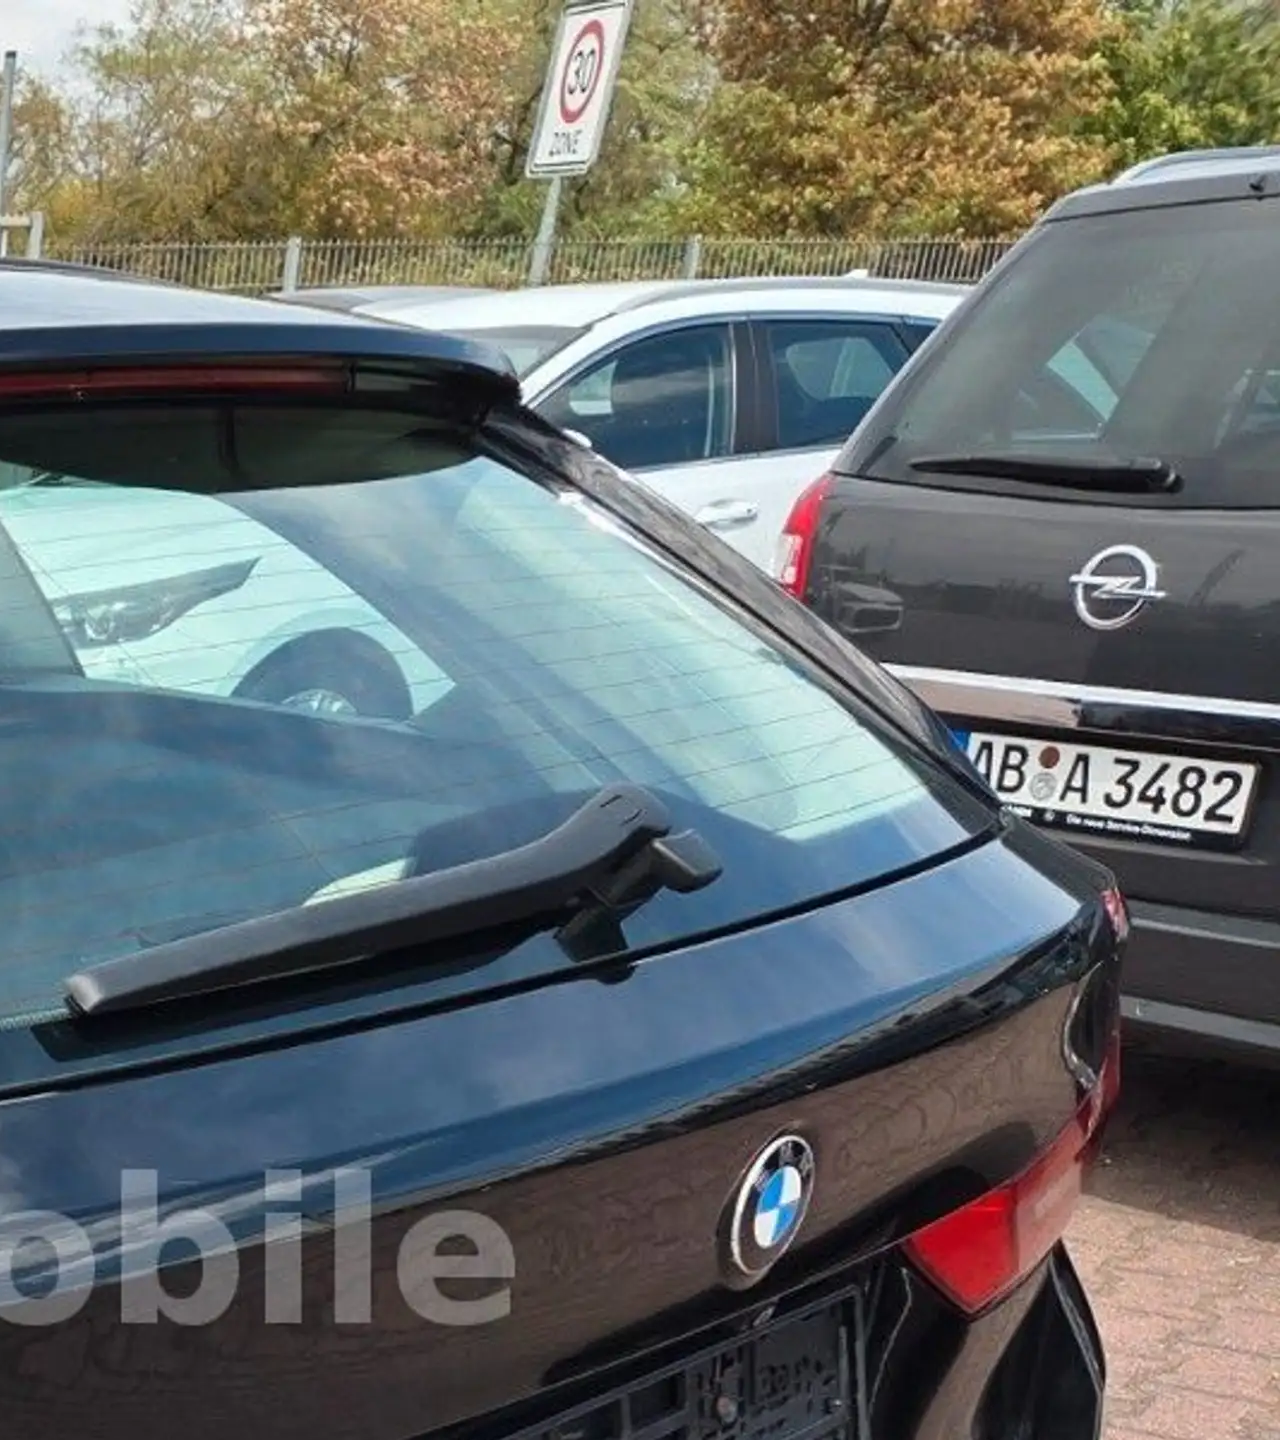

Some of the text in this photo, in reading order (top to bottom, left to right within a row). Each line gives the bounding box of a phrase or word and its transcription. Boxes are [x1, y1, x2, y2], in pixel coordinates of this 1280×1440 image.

[566, 48, 596, 95] 30
[548, 129, 582, 157] ZONE
[970, 741, 1244, 824] AB A 3482
